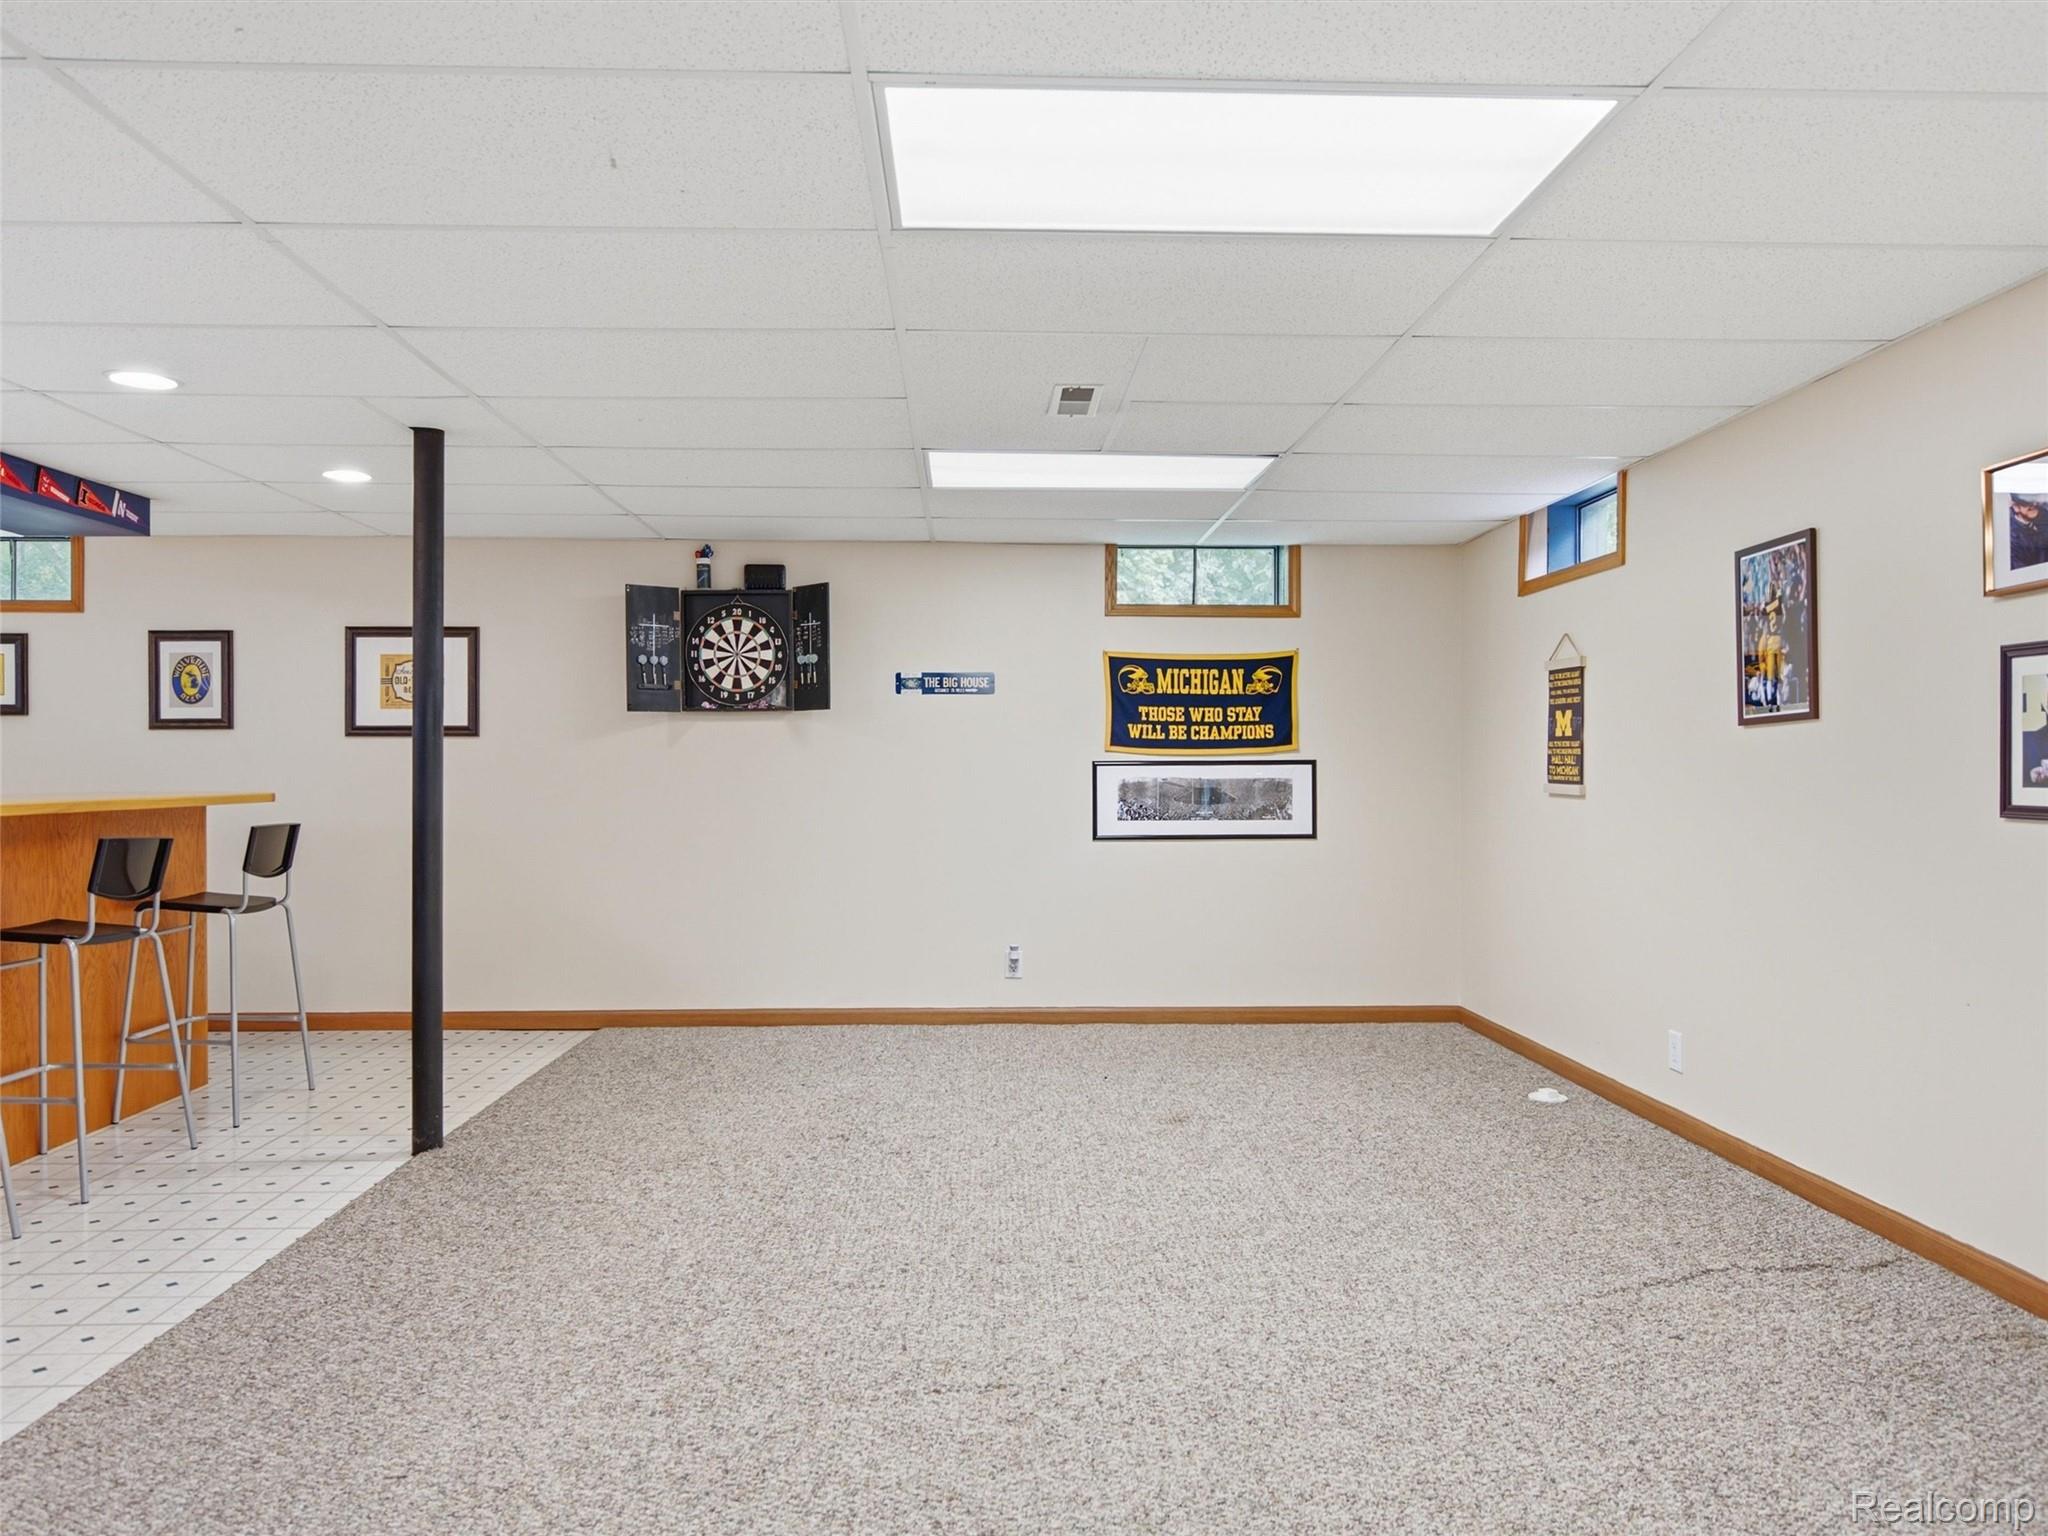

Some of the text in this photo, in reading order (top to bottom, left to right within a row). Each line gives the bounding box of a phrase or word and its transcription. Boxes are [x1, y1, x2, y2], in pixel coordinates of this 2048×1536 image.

[732, 608, 742, 616] 20
[692, 637, 700, 645] 14
[691, 650, 698, 658] 11
[923, 677, 990, 688] THE BIG HOUSE
[1156, 667, 1245, 695] MICHIGAN
[720, 691, 729, 699] 19
[747, 691, 755, 699] 17
[1138, 706, 1263, 722] THOSE WHO STAY
[1555, 709, 1573, 737] M
[1127, 723, 1275, 740] WILL BE CHAMPIONS
